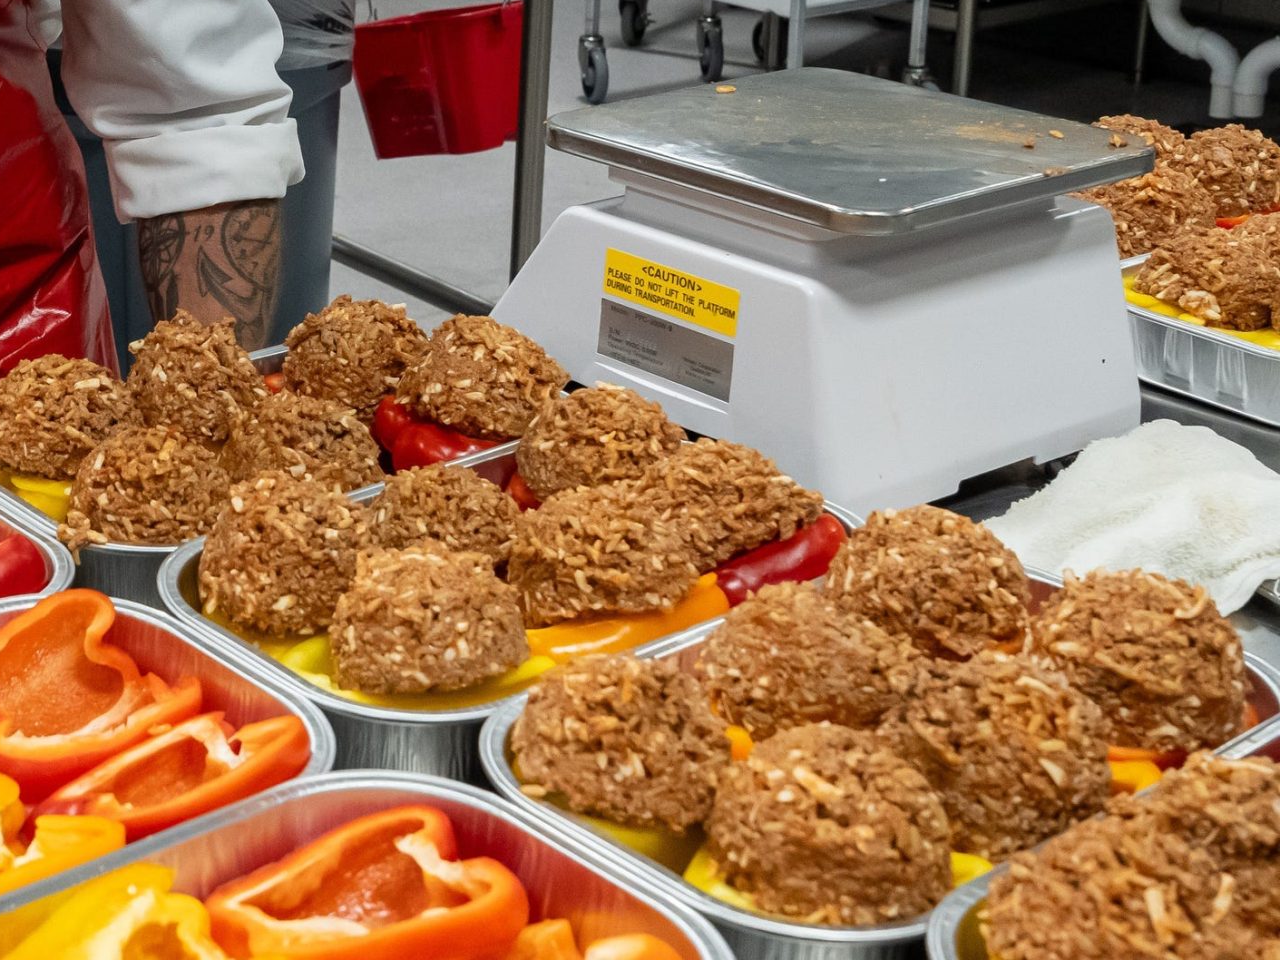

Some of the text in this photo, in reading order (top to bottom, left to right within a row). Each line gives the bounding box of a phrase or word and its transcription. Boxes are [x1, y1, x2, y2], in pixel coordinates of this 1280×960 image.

[606, 278, 696, 317] DURING TRANSPORTATION.
[608, 267, 736, 320] PLEASE DO NOT LIFT THE PLATFORM
